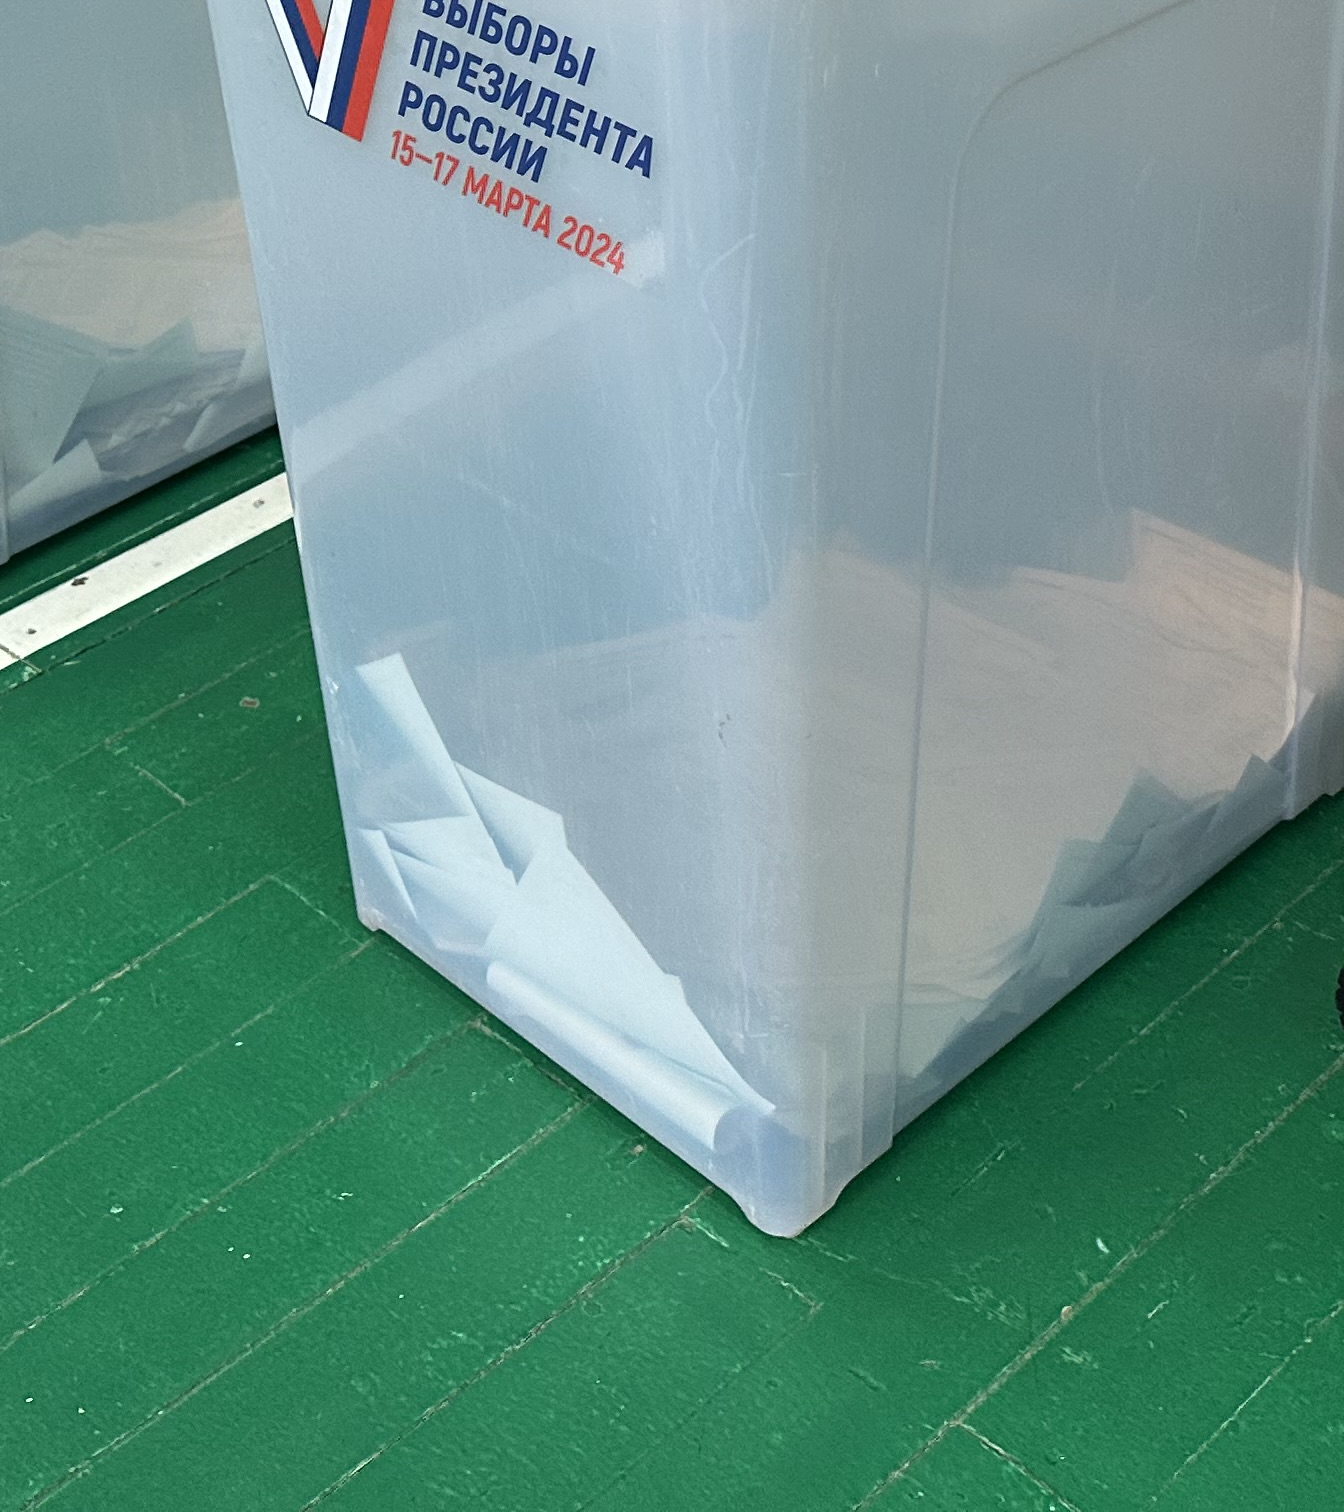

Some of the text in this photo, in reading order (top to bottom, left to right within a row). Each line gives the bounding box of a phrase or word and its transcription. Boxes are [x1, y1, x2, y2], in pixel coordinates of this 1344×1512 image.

[397, 81, 548, 183] РОССИИ
[409, 29, 654, 179] ПРЕЗИДЕНТА
[462, 166, 552, 238] МАРТА
[557, 215, 626, 275] 2024
